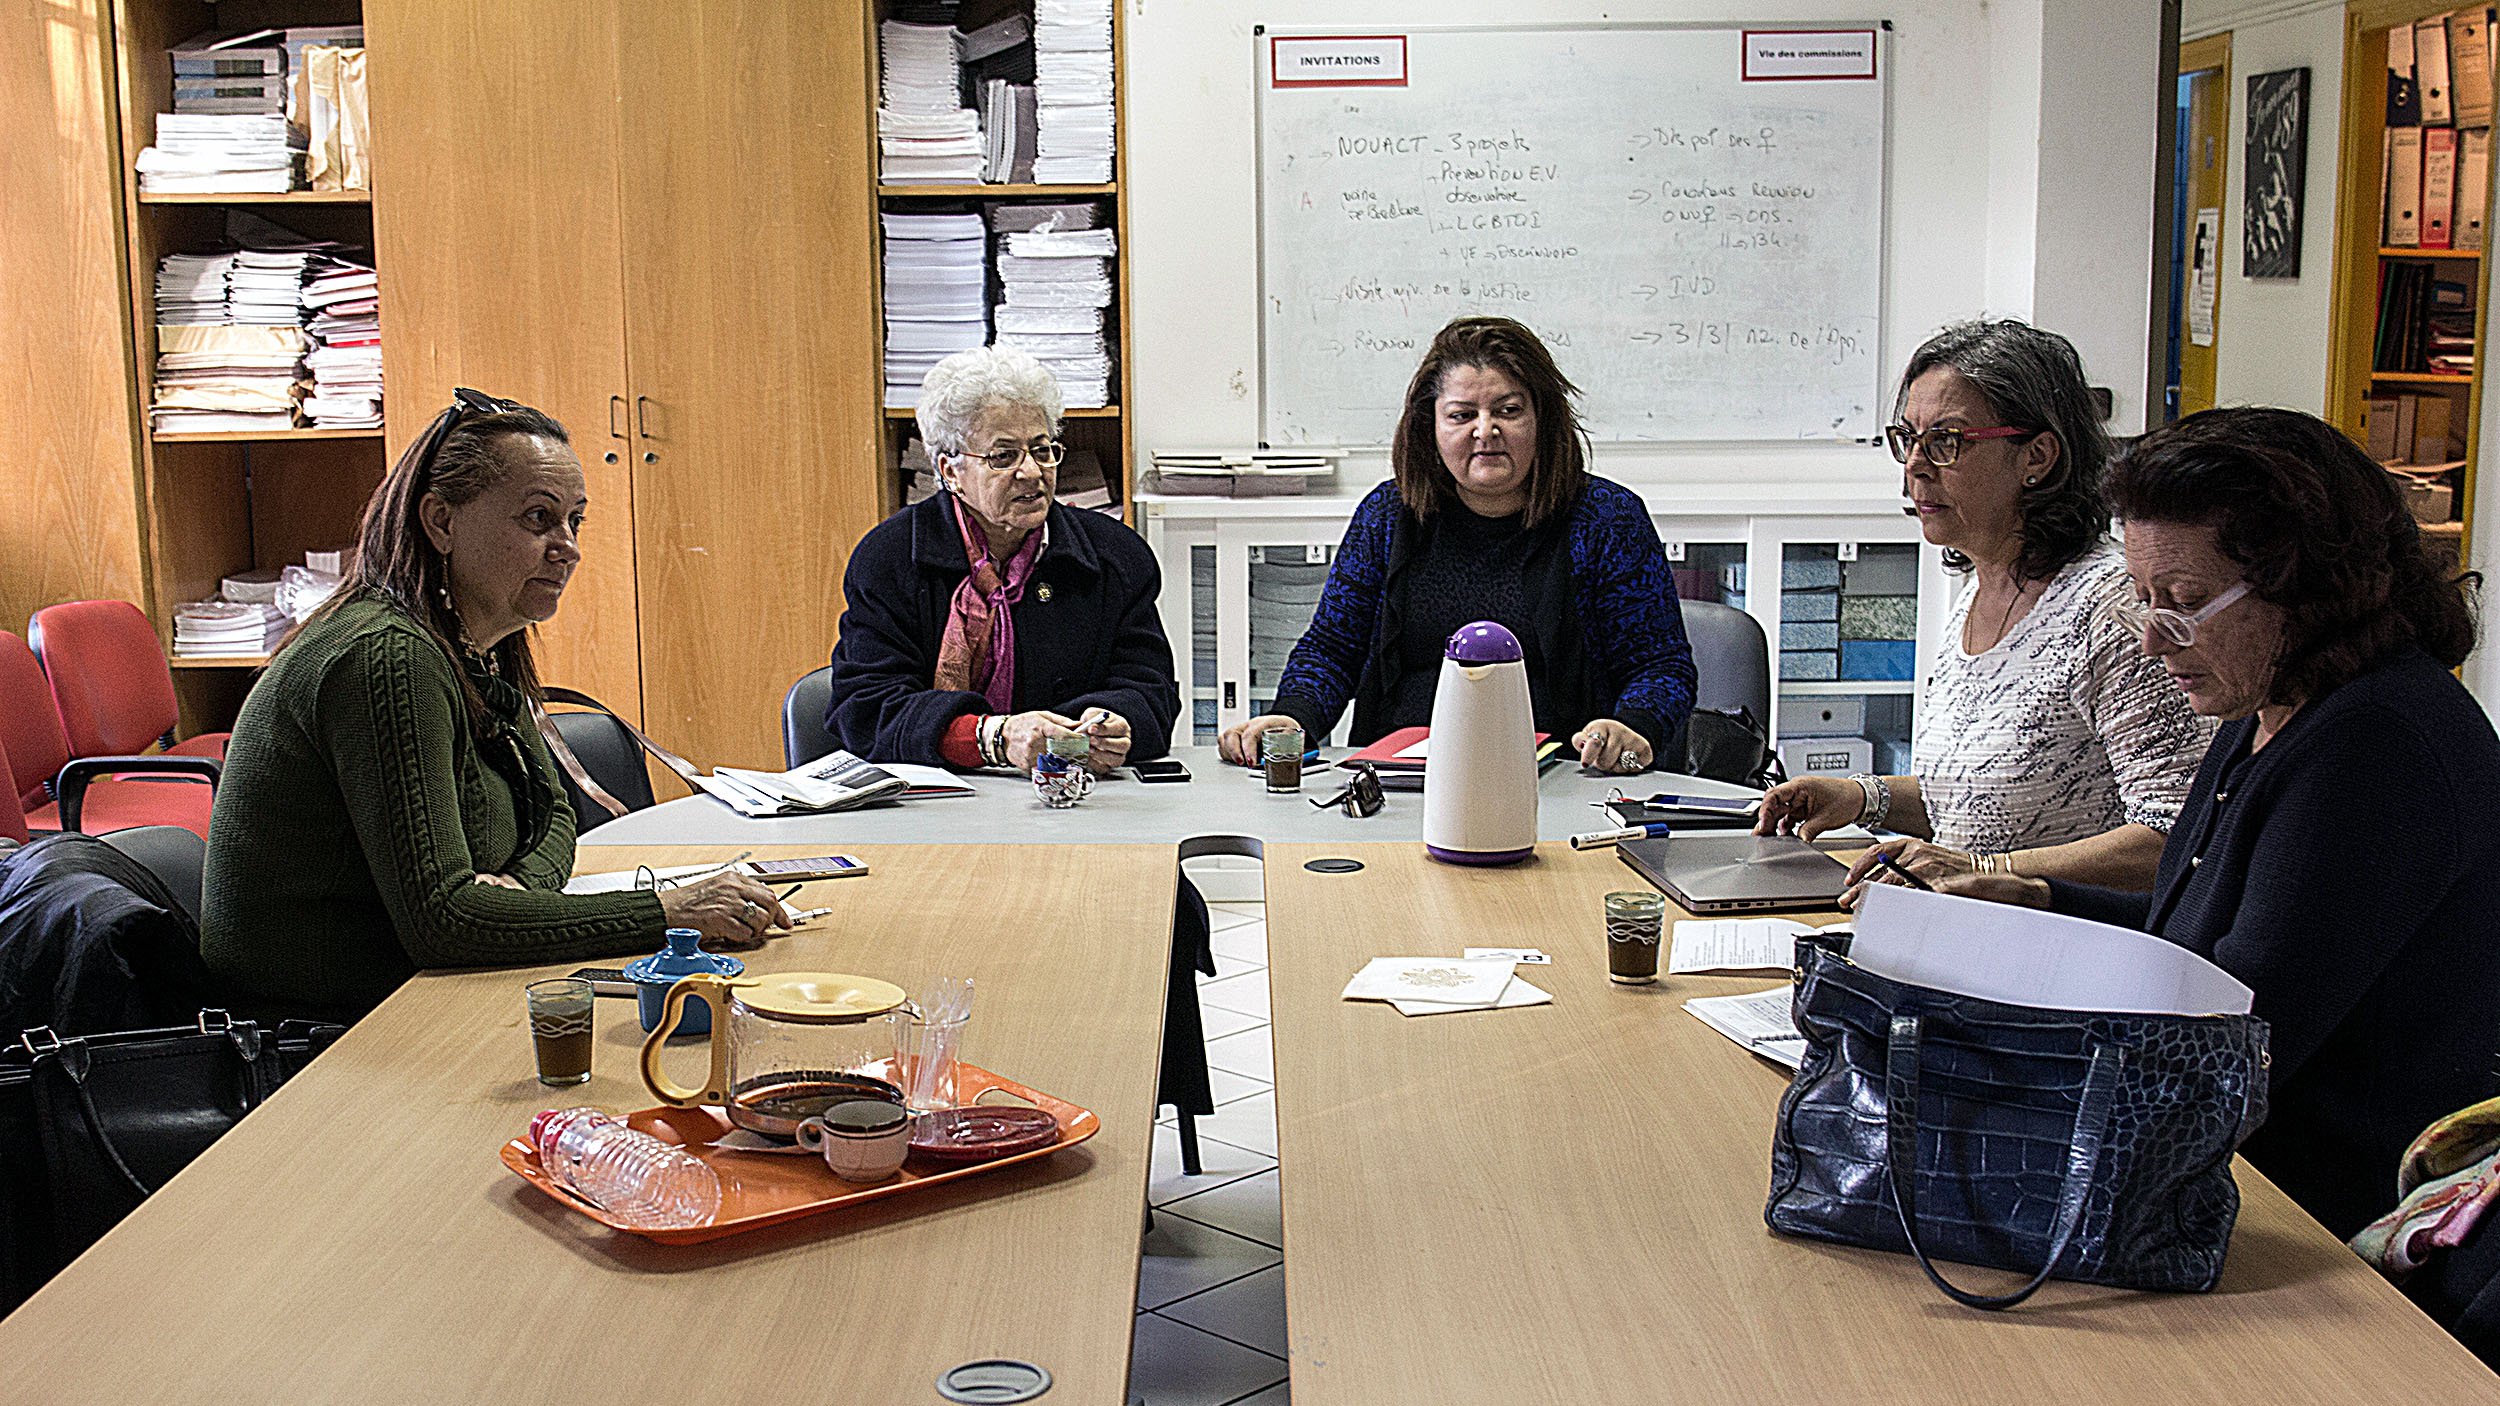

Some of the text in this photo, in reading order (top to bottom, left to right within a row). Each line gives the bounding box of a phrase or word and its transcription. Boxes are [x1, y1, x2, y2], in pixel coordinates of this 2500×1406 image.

[1759, 49, 1862, 58] Vie des commissions
[1300, 56, 1380, 66] INVITATIONS
